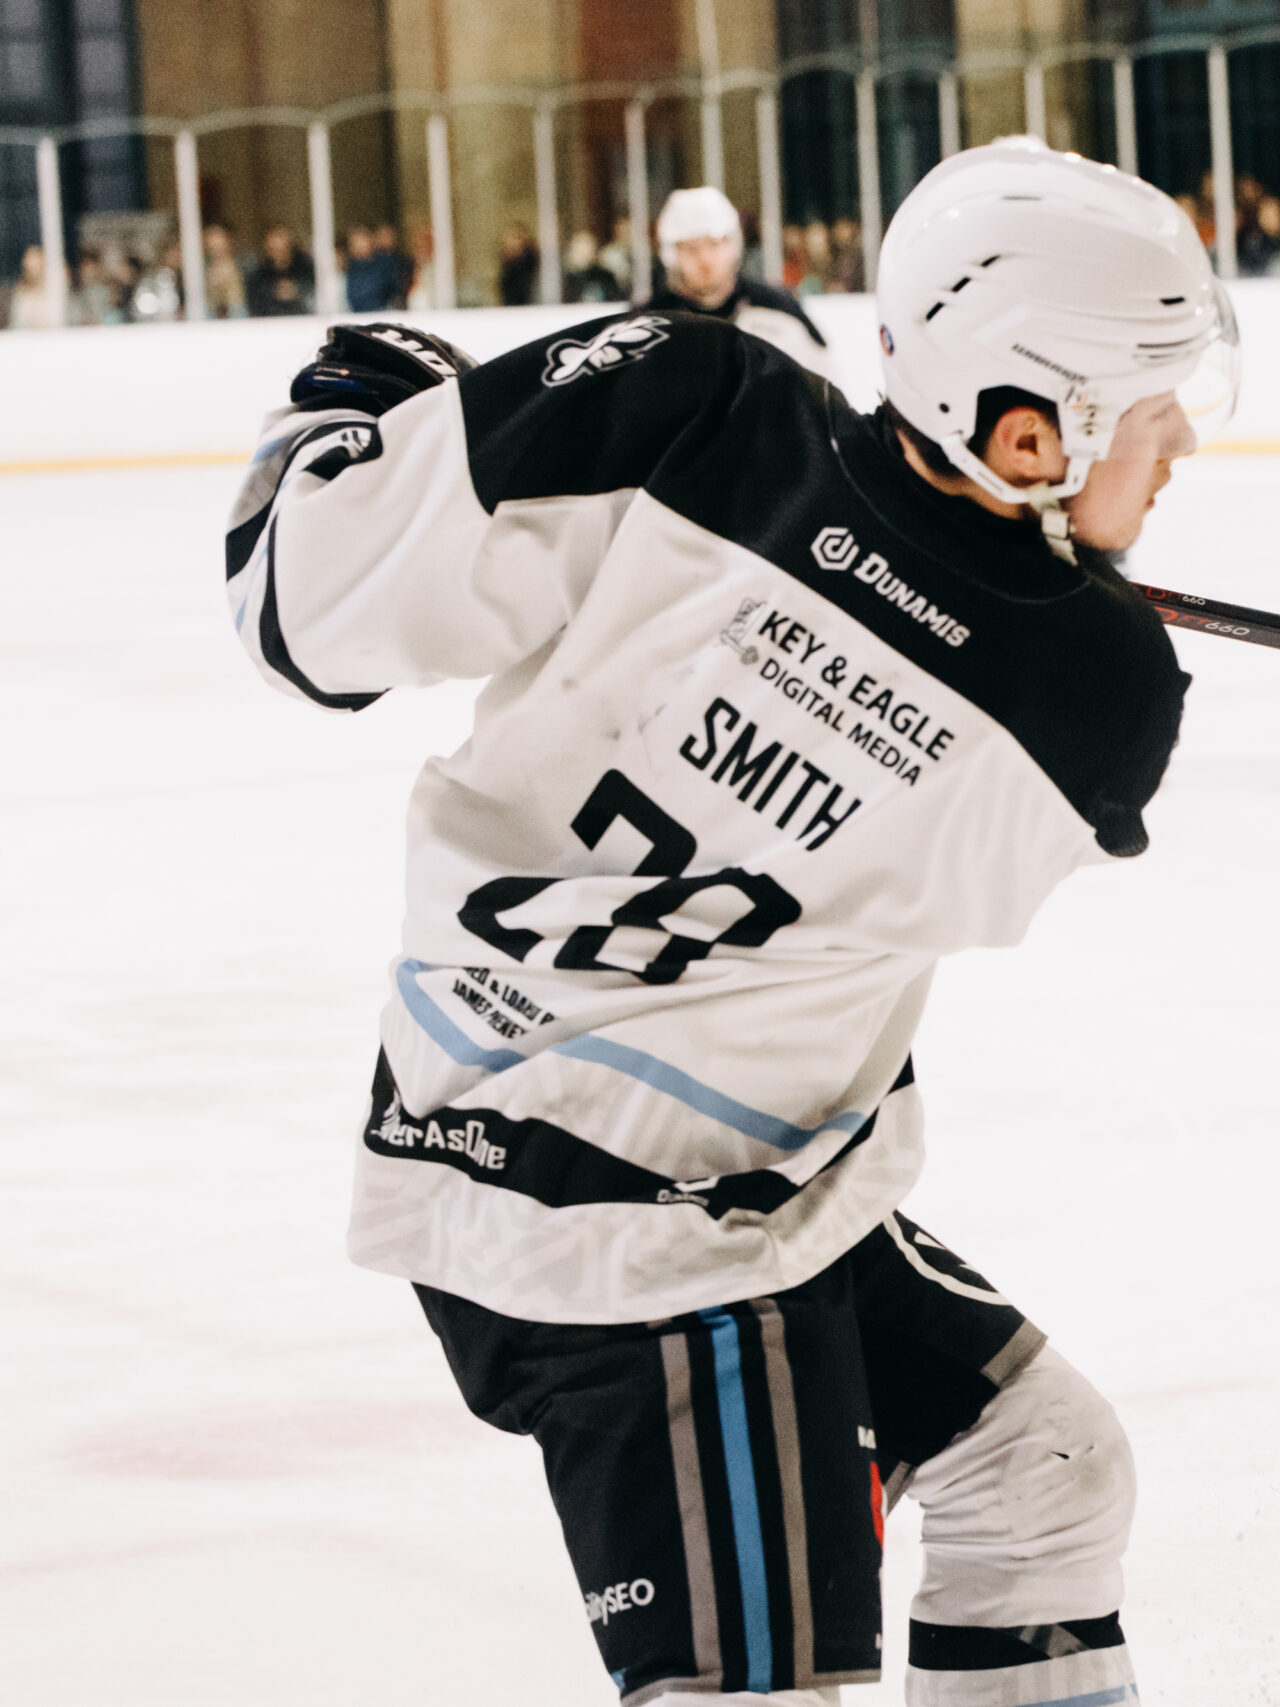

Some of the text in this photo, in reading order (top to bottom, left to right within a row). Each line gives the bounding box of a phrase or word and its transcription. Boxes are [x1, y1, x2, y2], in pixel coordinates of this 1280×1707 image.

[1182, 595, 1206, 606] 660
[1204, 621, 1251, 637] 660
[758, 610, 955, 762] KEY & EAGLE
[758, 657, 922, 787] DIGITAL MEDIA
[679, 697, 862, 852] SMITH
